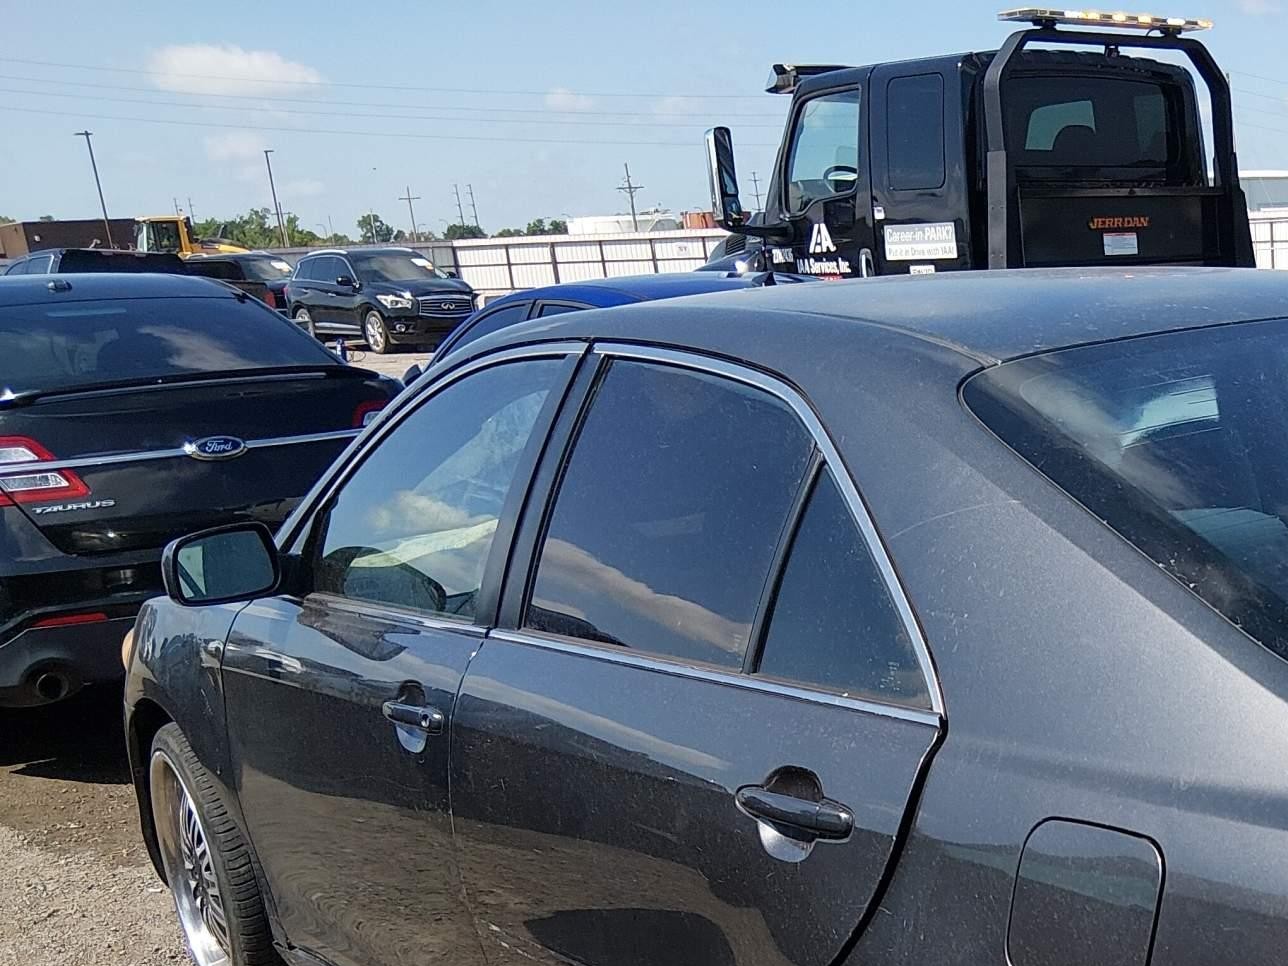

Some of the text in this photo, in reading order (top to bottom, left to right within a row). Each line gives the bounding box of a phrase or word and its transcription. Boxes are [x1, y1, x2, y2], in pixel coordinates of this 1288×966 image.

[925, 226, 953, 241] PARK?
[809, 257, 839, 274] Services,
[838, 257, 852, 273] Inc.
[205, 440, 233, 453] Ford
[31, 499, 115, 514] TAURUS
